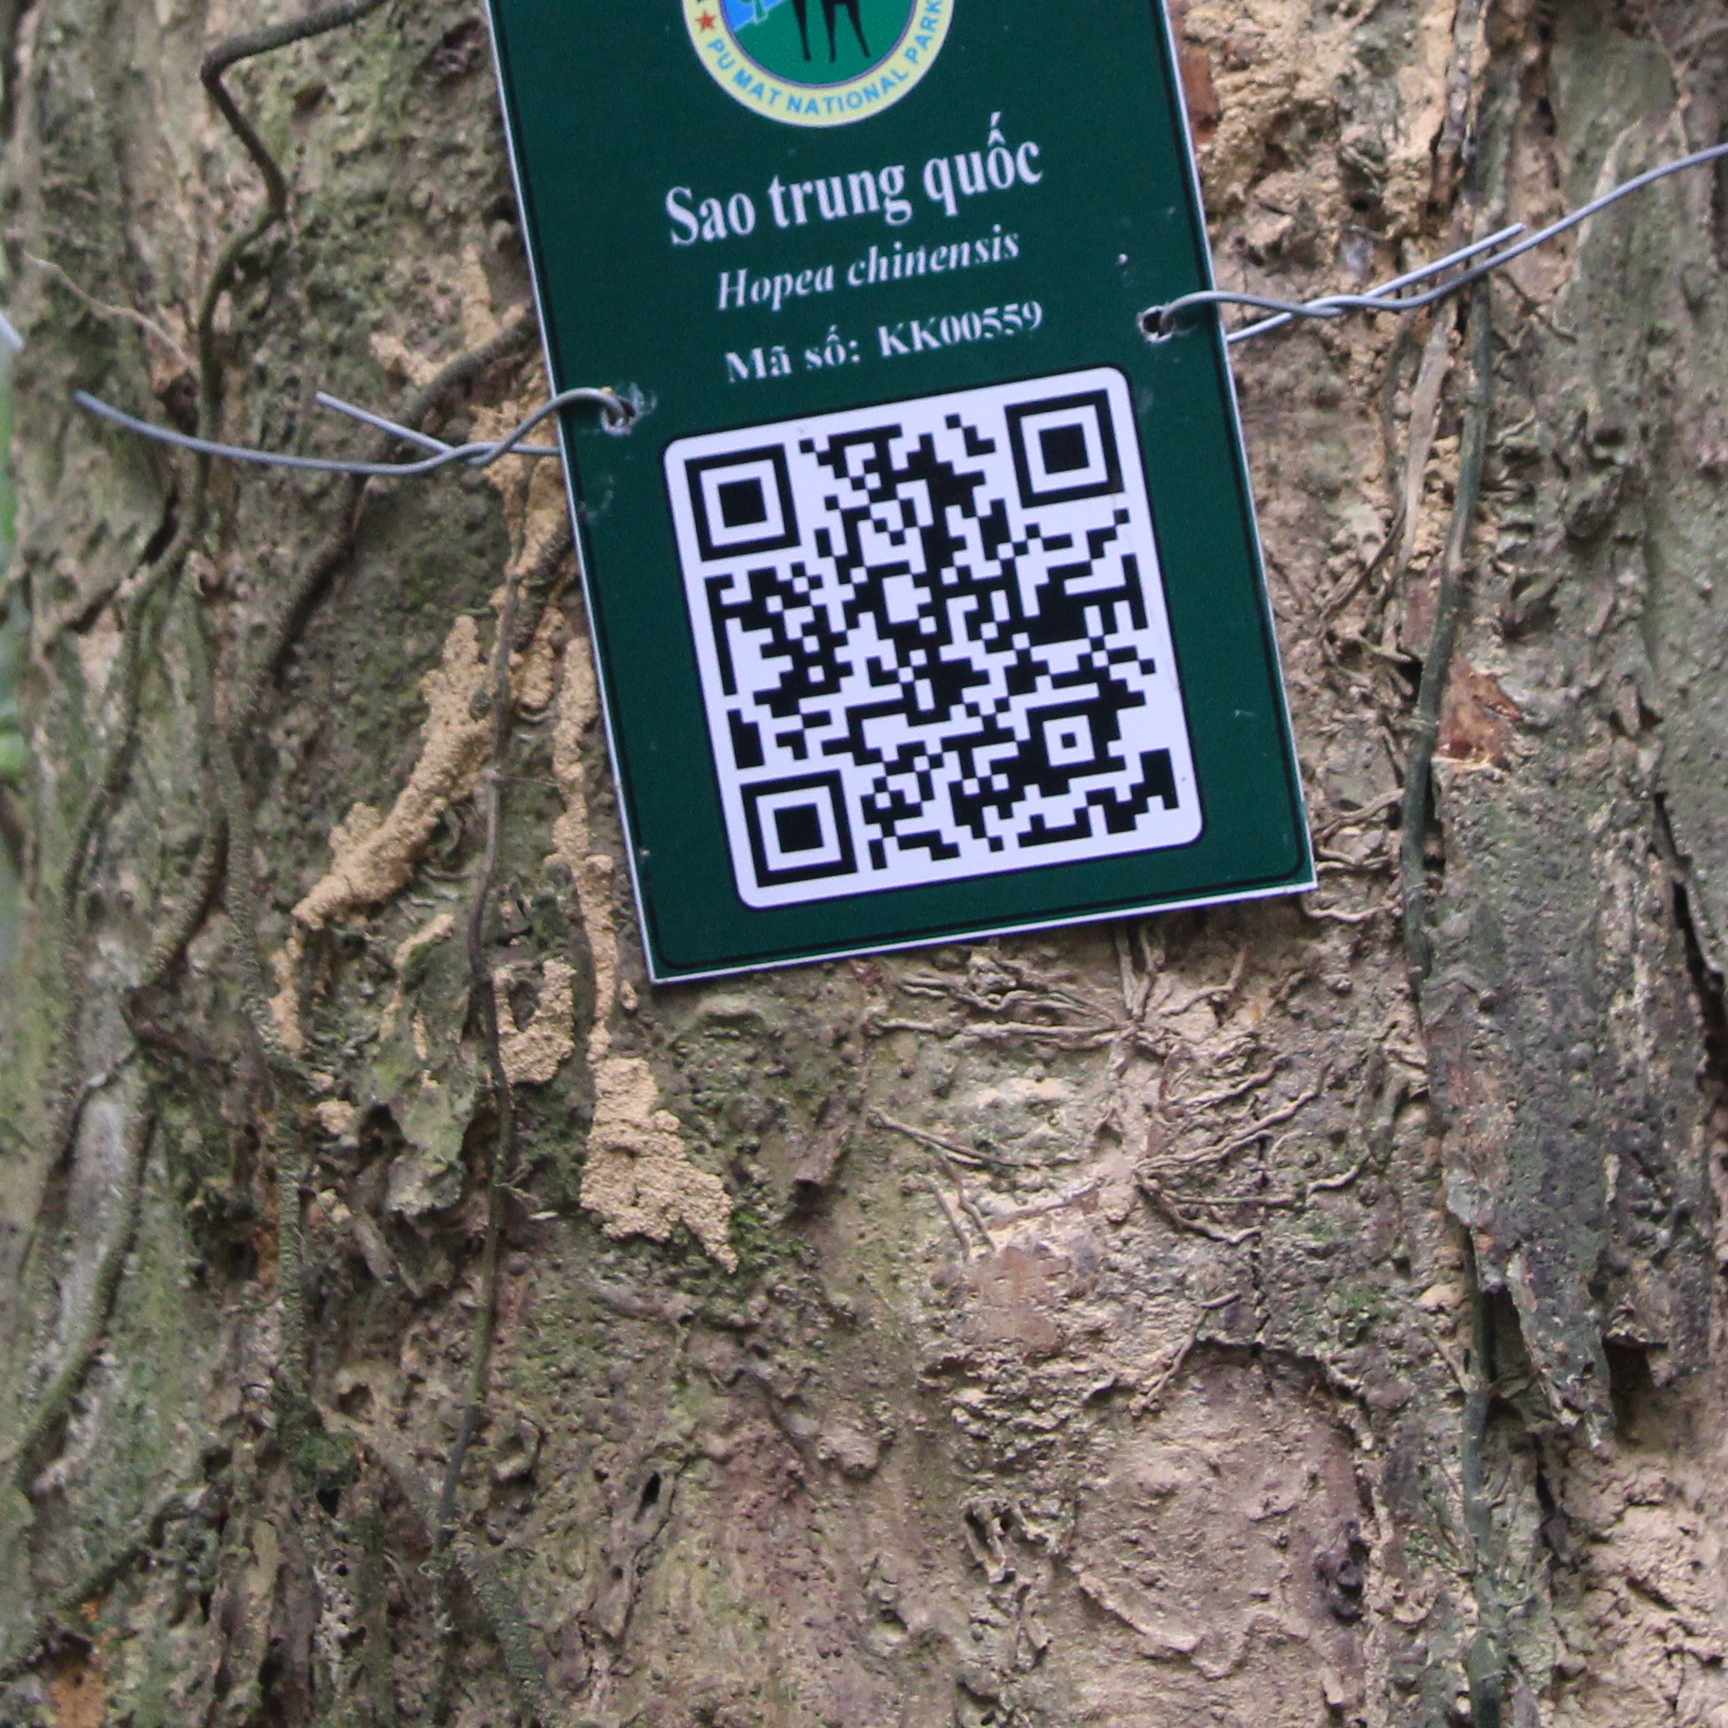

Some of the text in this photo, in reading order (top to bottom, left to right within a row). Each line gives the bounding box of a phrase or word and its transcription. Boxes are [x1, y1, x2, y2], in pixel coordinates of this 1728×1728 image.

[707, 37, 737, 71] PU
[732, 67, 783, 106] MAT
[785, 69, 909, 116] NATIONAL
[664, 111, 1043, 245] Sao trung quốc
[717, 223, 1021, 312] Hopea chinensis
[723, 300, 1043, 384] Mã số: KK00559
